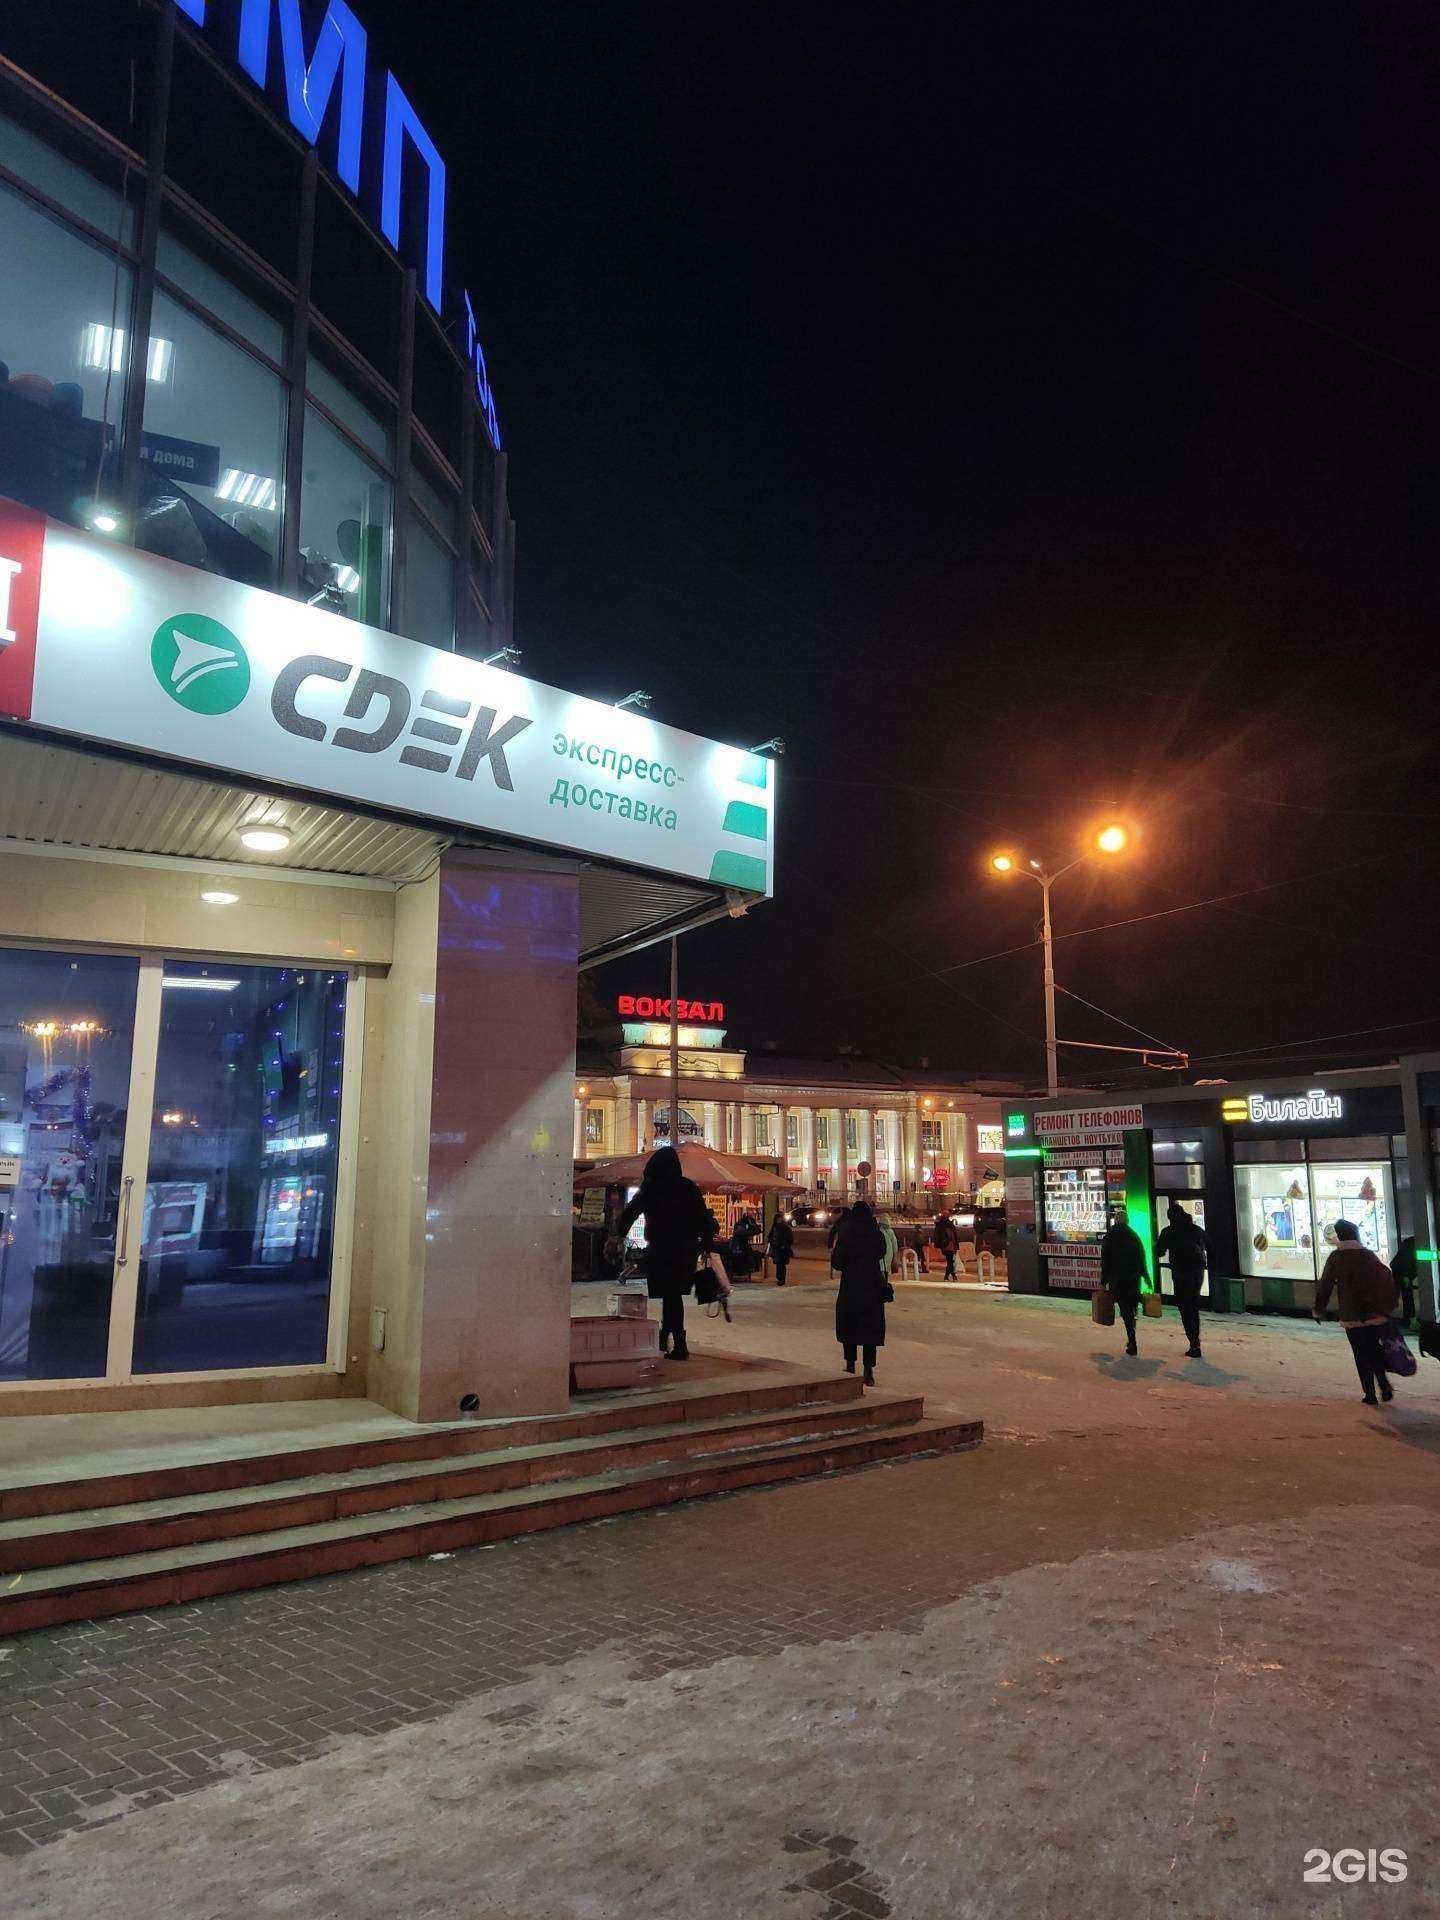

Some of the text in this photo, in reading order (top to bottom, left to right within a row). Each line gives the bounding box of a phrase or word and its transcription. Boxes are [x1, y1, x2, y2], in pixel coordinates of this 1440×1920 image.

[270, 654, 535, 793] CDEK
[552, 732, 686, 788] экспресс-
[548, 778, 679, 831] доставка
[617, 995, 725, 1022] ВОКЗАЛ
[1035, 1113, 1075, 1131] РЕМОНТ
[1078, 1108, 1142, 1129] ТЕЛЕФОНОВ
[1066, 1244, 1099, 1256] ПРОДАЖА
